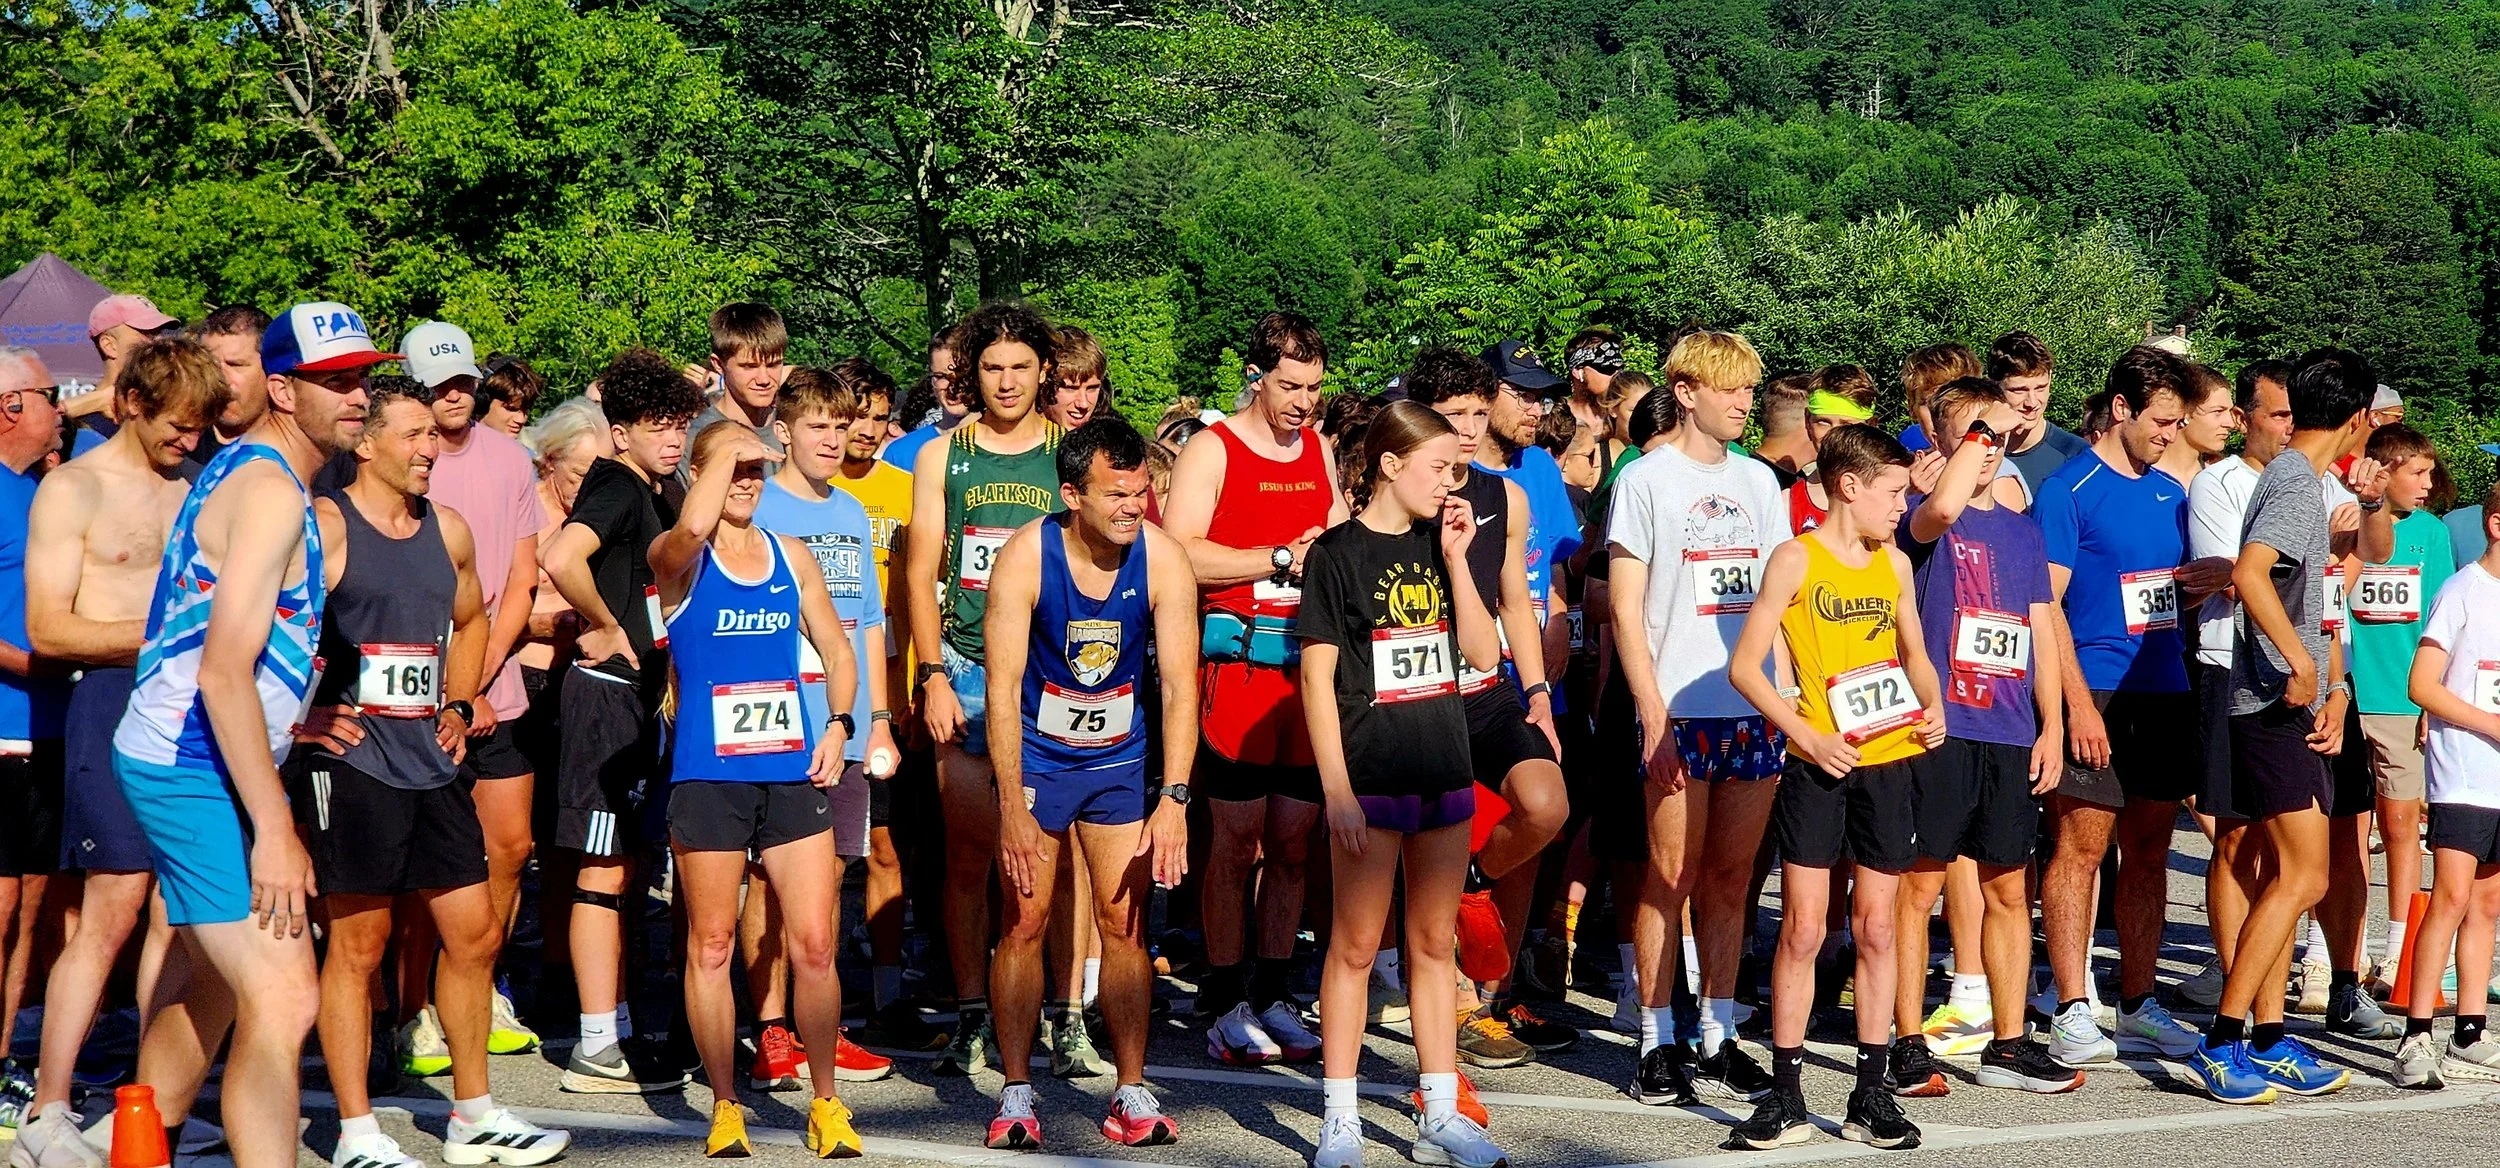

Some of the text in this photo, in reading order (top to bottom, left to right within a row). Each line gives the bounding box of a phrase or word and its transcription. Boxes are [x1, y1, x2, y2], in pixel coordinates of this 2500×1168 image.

[429, 343, 461, 357] USA
[965, 483, 1051, 513] CLARKSON
[1259, 481, 1316, 492] JESUS IS KING
[1710, 566, 1753, 596] 331
[2362, 581, 2409, 605] 566
[1832, 597, 1892, 618] LAKERS
[2139, 586, 2175, 615] 355
[712, 608, 791, 636] Dirigo
[1973, 627, 2019, 660] 531
[1391, 643, 1442, 679] 571
[382, 665, 431, 696] 169
[1845, 678, 1905, 717] 572
[732, 700, 790, 733] 274
[1067, 707, 1107, 733] 75
